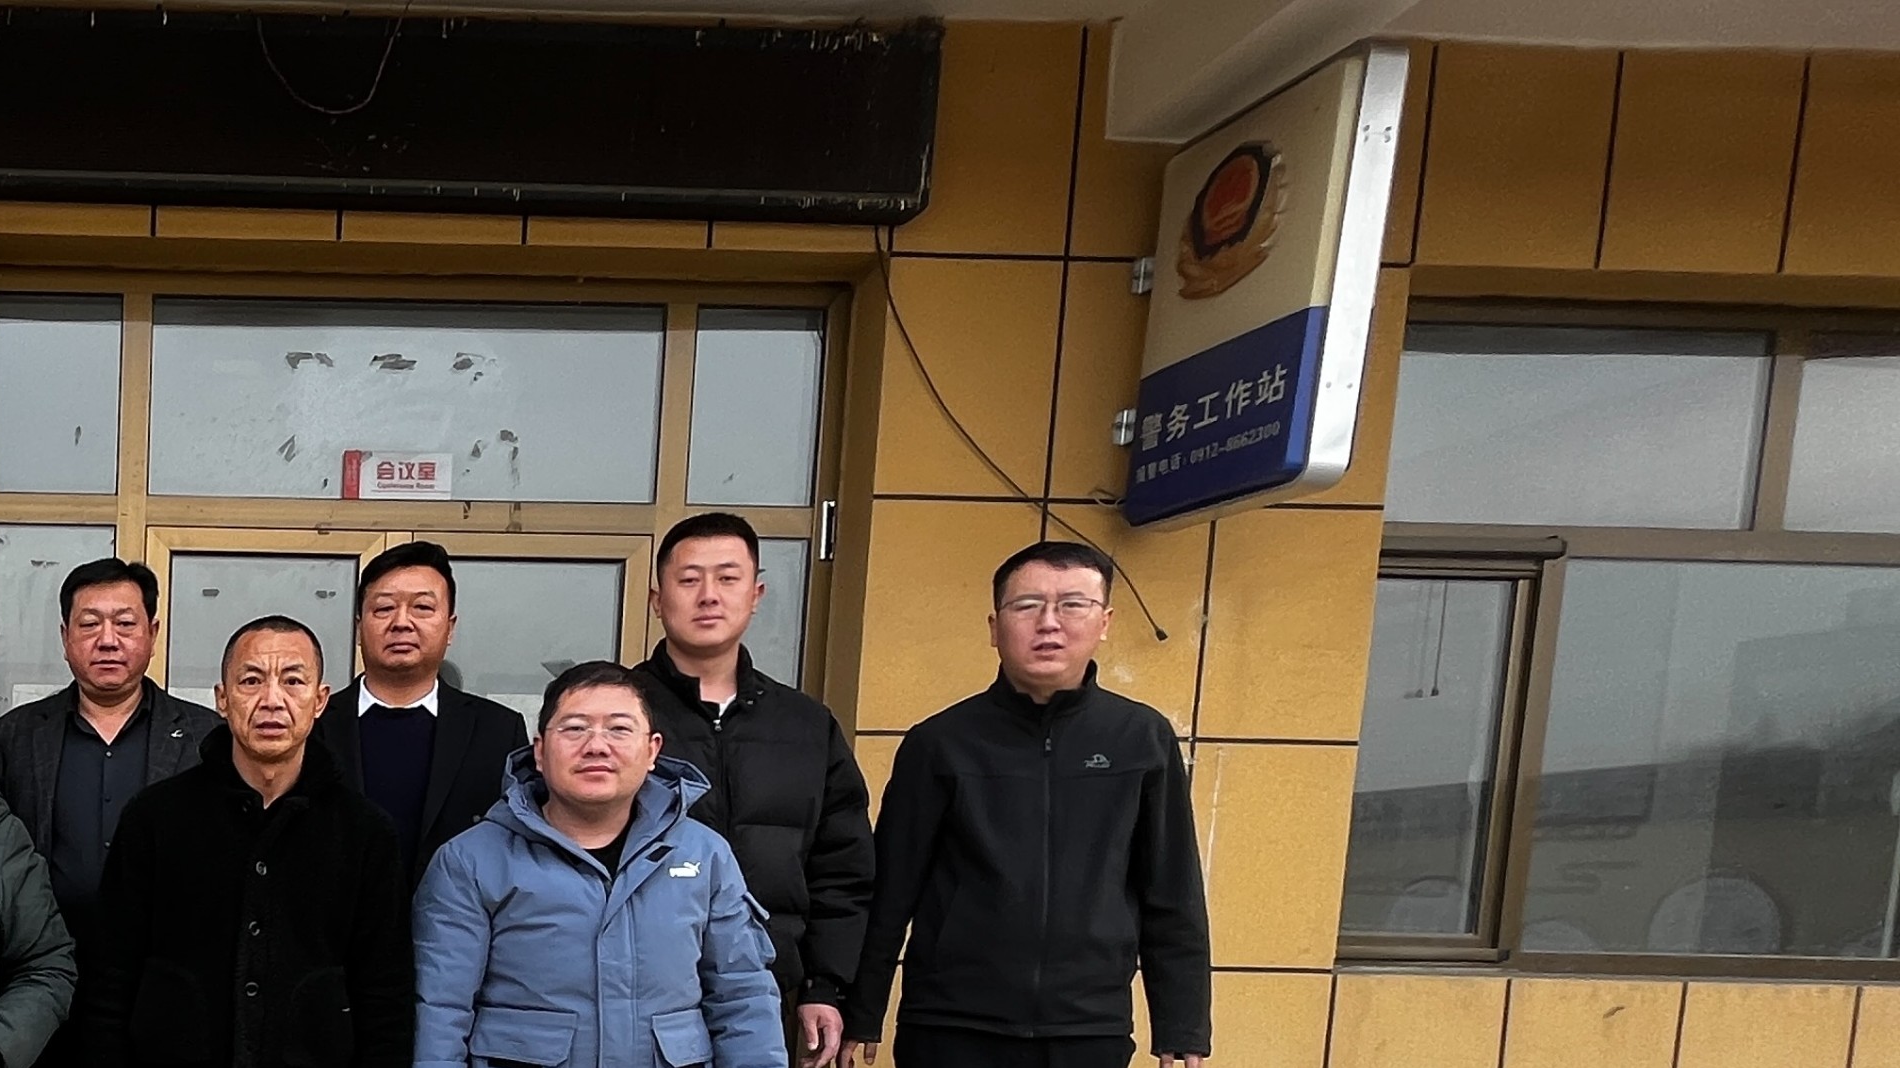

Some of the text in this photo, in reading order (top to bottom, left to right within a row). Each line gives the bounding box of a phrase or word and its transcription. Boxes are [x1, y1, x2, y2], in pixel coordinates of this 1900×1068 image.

[1140, 363, 1287, 451] 警务工作站
[377, 461, 436, 480] 会议室
